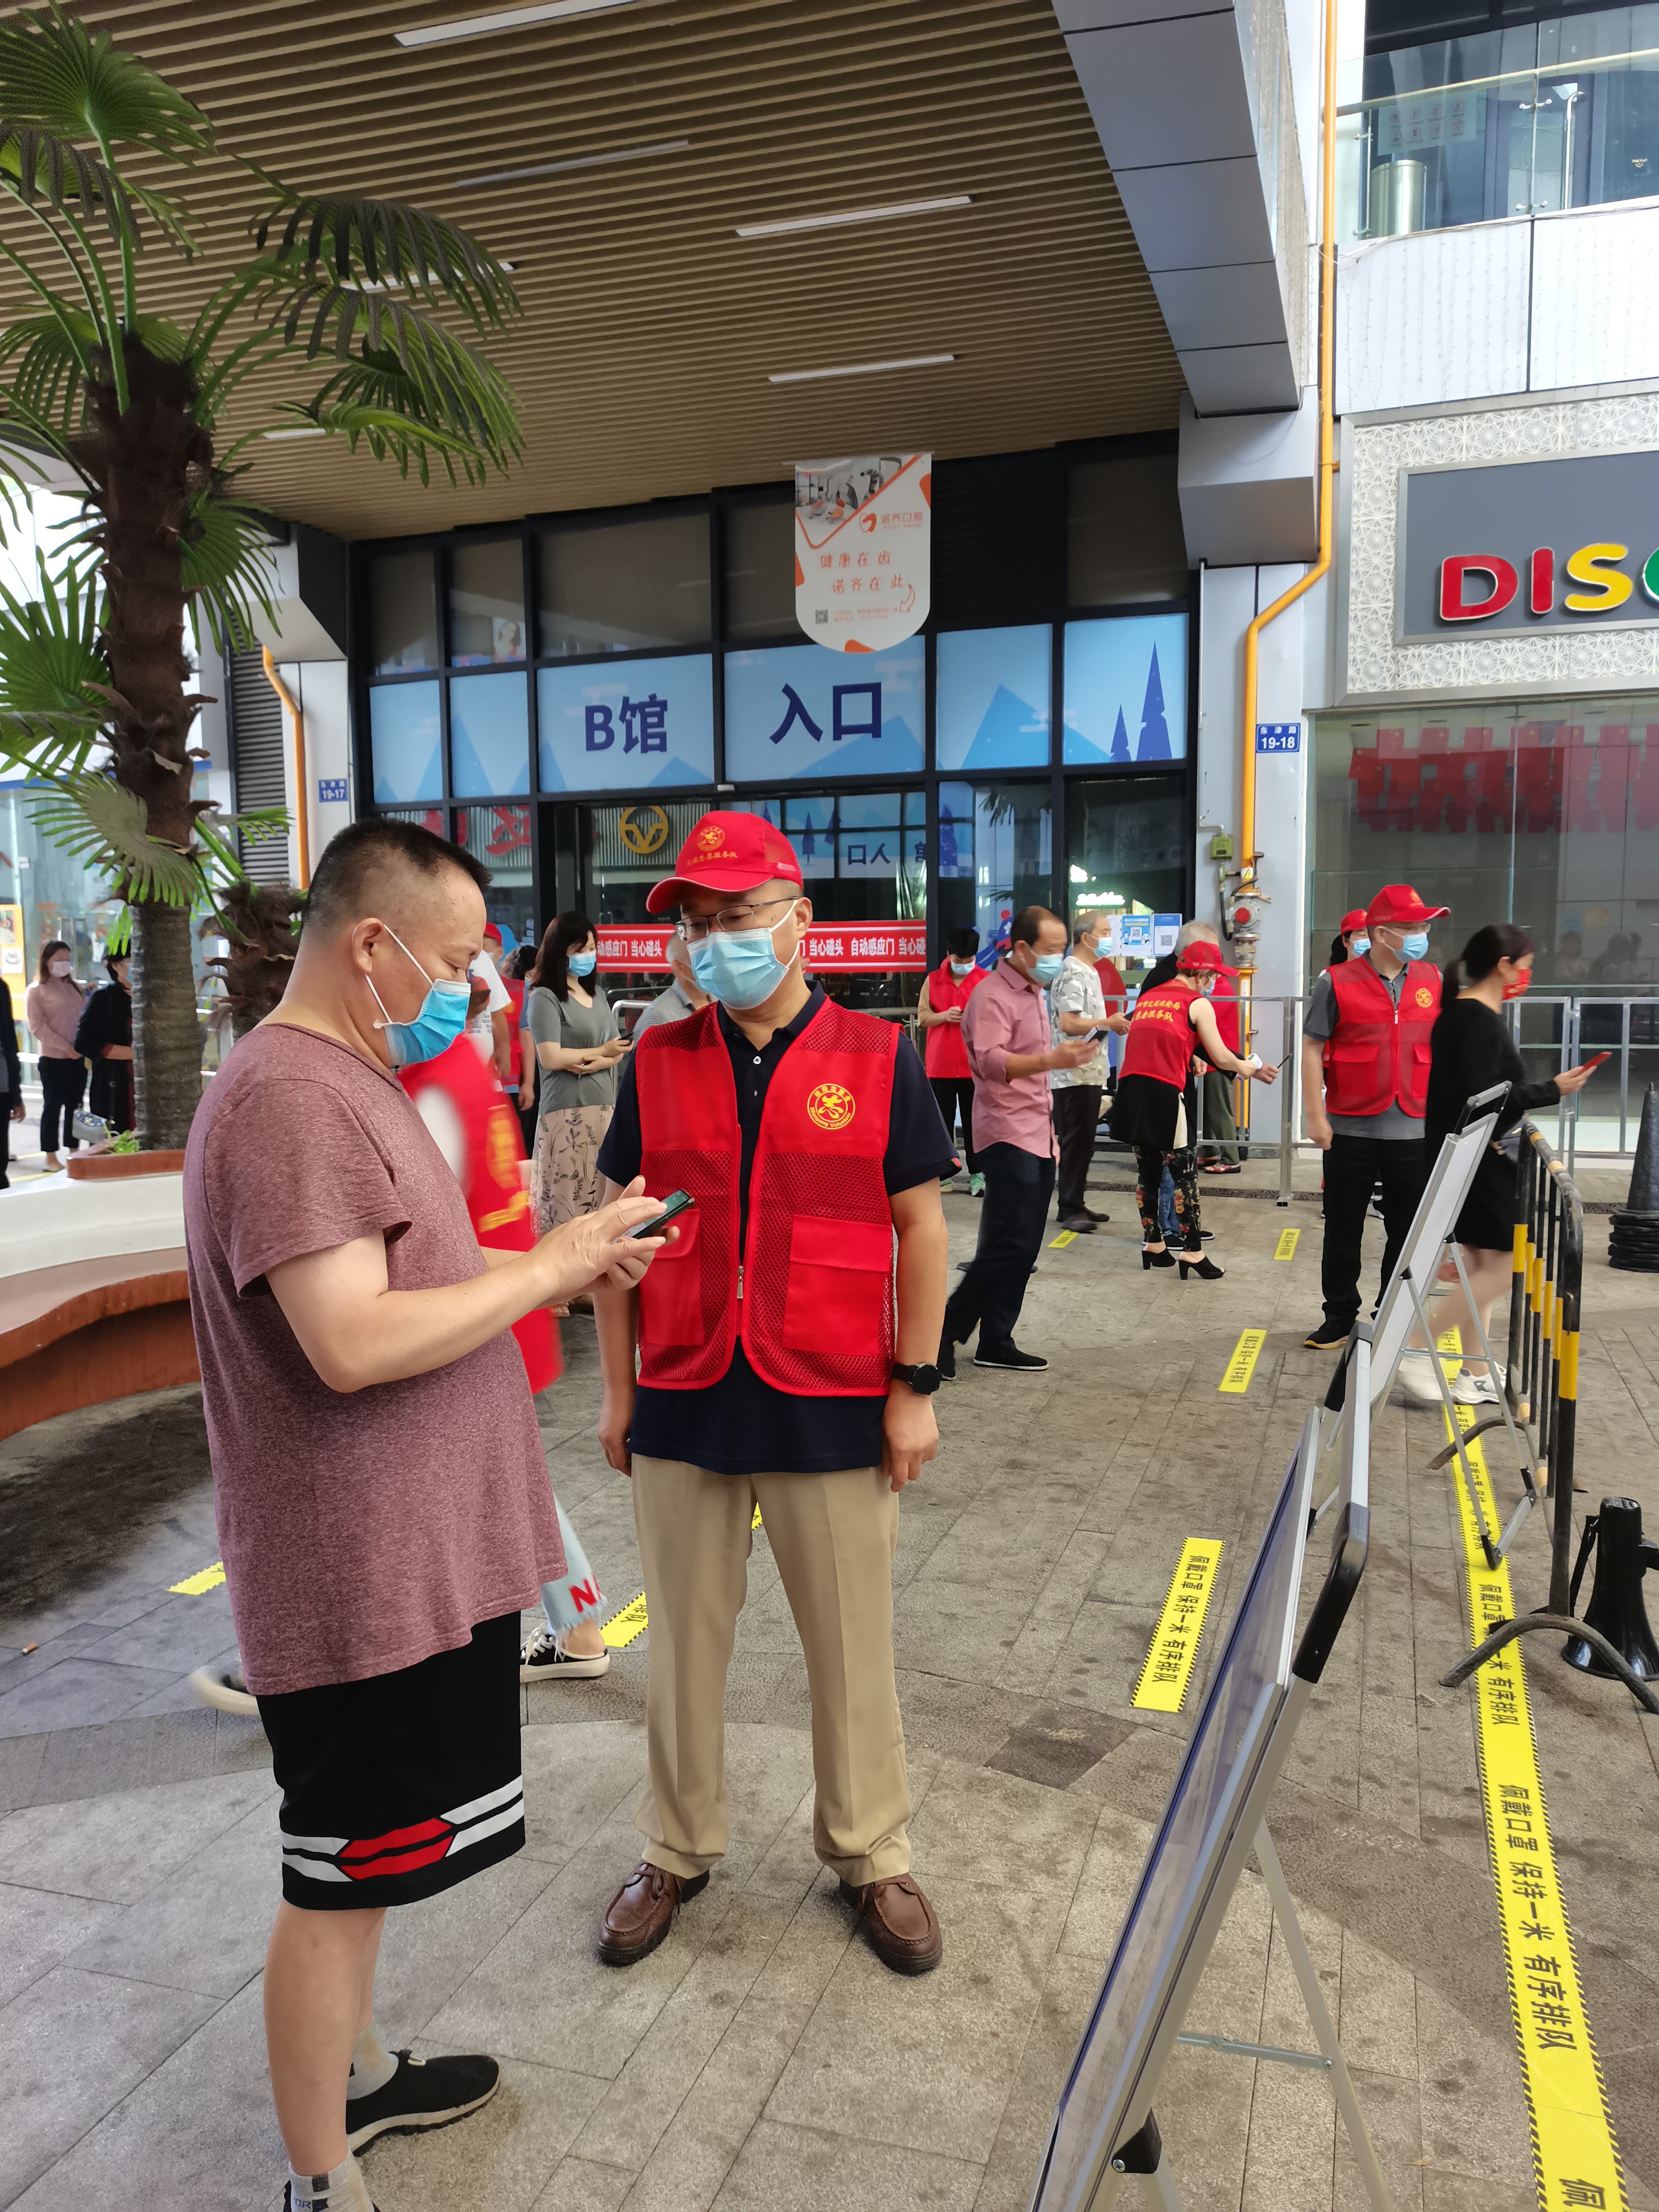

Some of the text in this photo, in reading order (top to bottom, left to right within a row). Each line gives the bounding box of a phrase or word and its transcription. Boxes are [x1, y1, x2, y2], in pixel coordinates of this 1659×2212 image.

[1440, 543, 1659, 621] DIS
[585, 682, 882, 754] B馆 入口
[1261, 736, 1296, 749] 19-18
[322, 789, 345, 800] 19-17
[631, 939, 662, 953] 当心碰头
[809, 938, 843, 956] 当心碰头
[851, 937, 895, 956] 自动感应门
[1152, 1555, 1210, 1683] 佩戴口罩 保持一米 有序排队
[1488, 1677, 1520, 1726] 有序排队
[1498, 1784, 1578, 2051] 佩戴口罩 保持一米 有序排队
